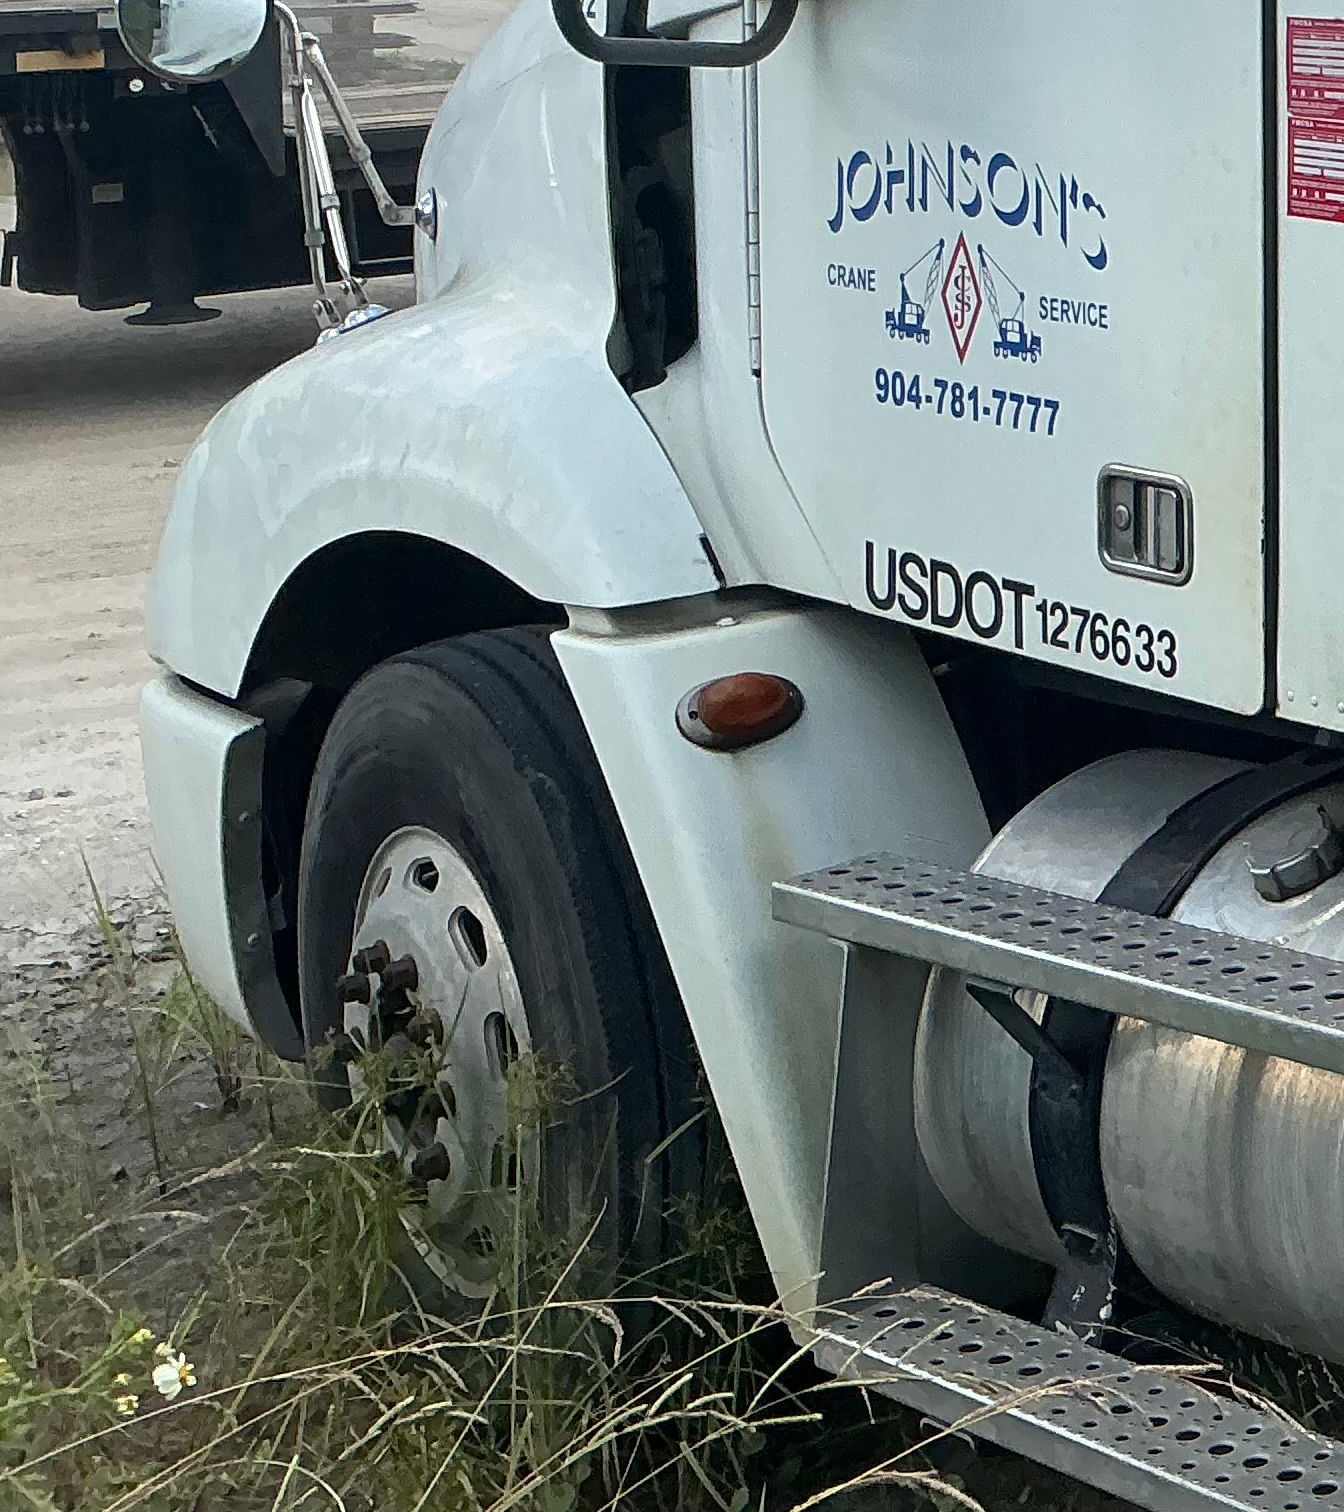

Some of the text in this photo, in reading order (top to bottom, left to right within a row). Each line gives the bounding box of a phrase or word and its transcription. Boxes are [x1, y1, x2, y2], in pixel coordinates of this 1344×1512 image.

[827, 138, 1108, 271] JOHNSON'S
[827, 263, 1109, 329] CRANE SERVICE
[875, 367, 1060, 436] 904-781-7777
